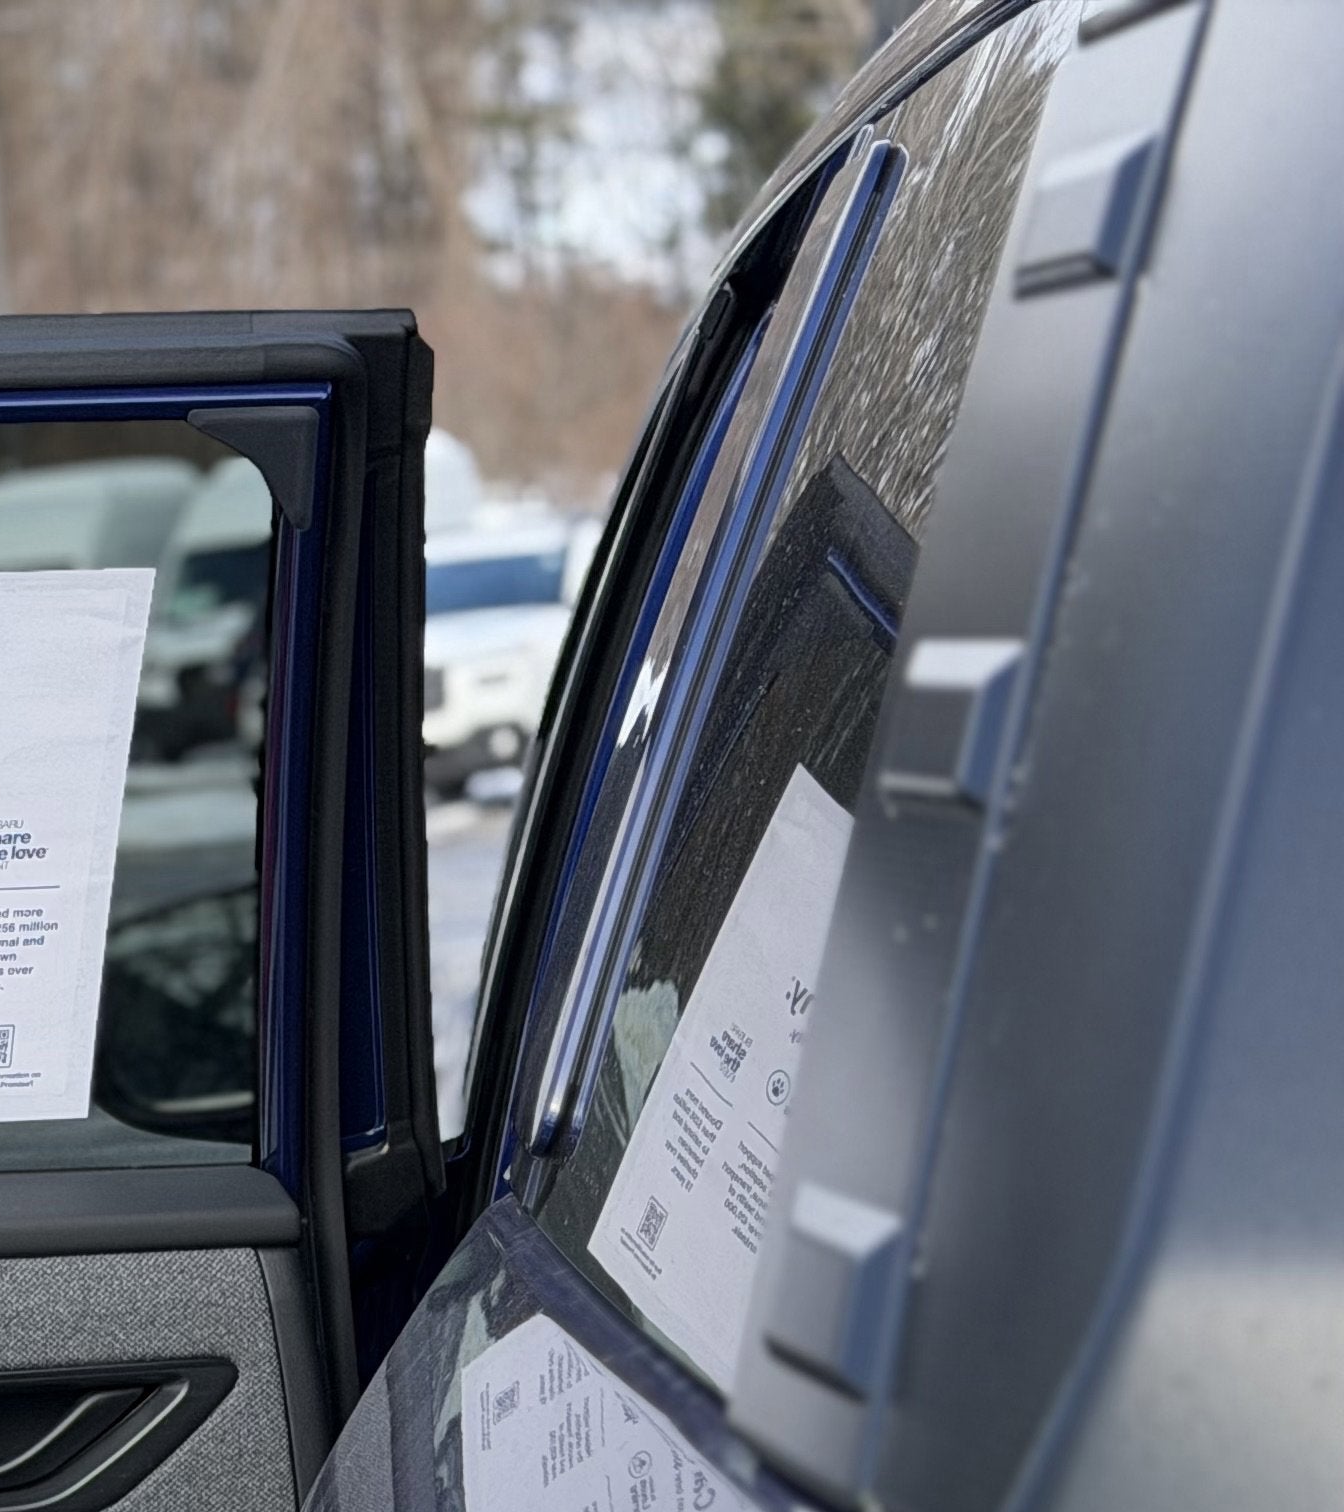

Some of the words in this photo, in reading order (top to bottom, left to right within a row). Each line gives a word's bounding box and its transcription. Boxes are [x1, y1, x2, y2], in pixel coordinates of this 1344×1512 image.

[11, 846, 47, 859] love
[13, 909, 43, 917] more
[19, 921, 58, 931] million
[22, 935, 44, 946] and
[7, 966, 33, 975] over
